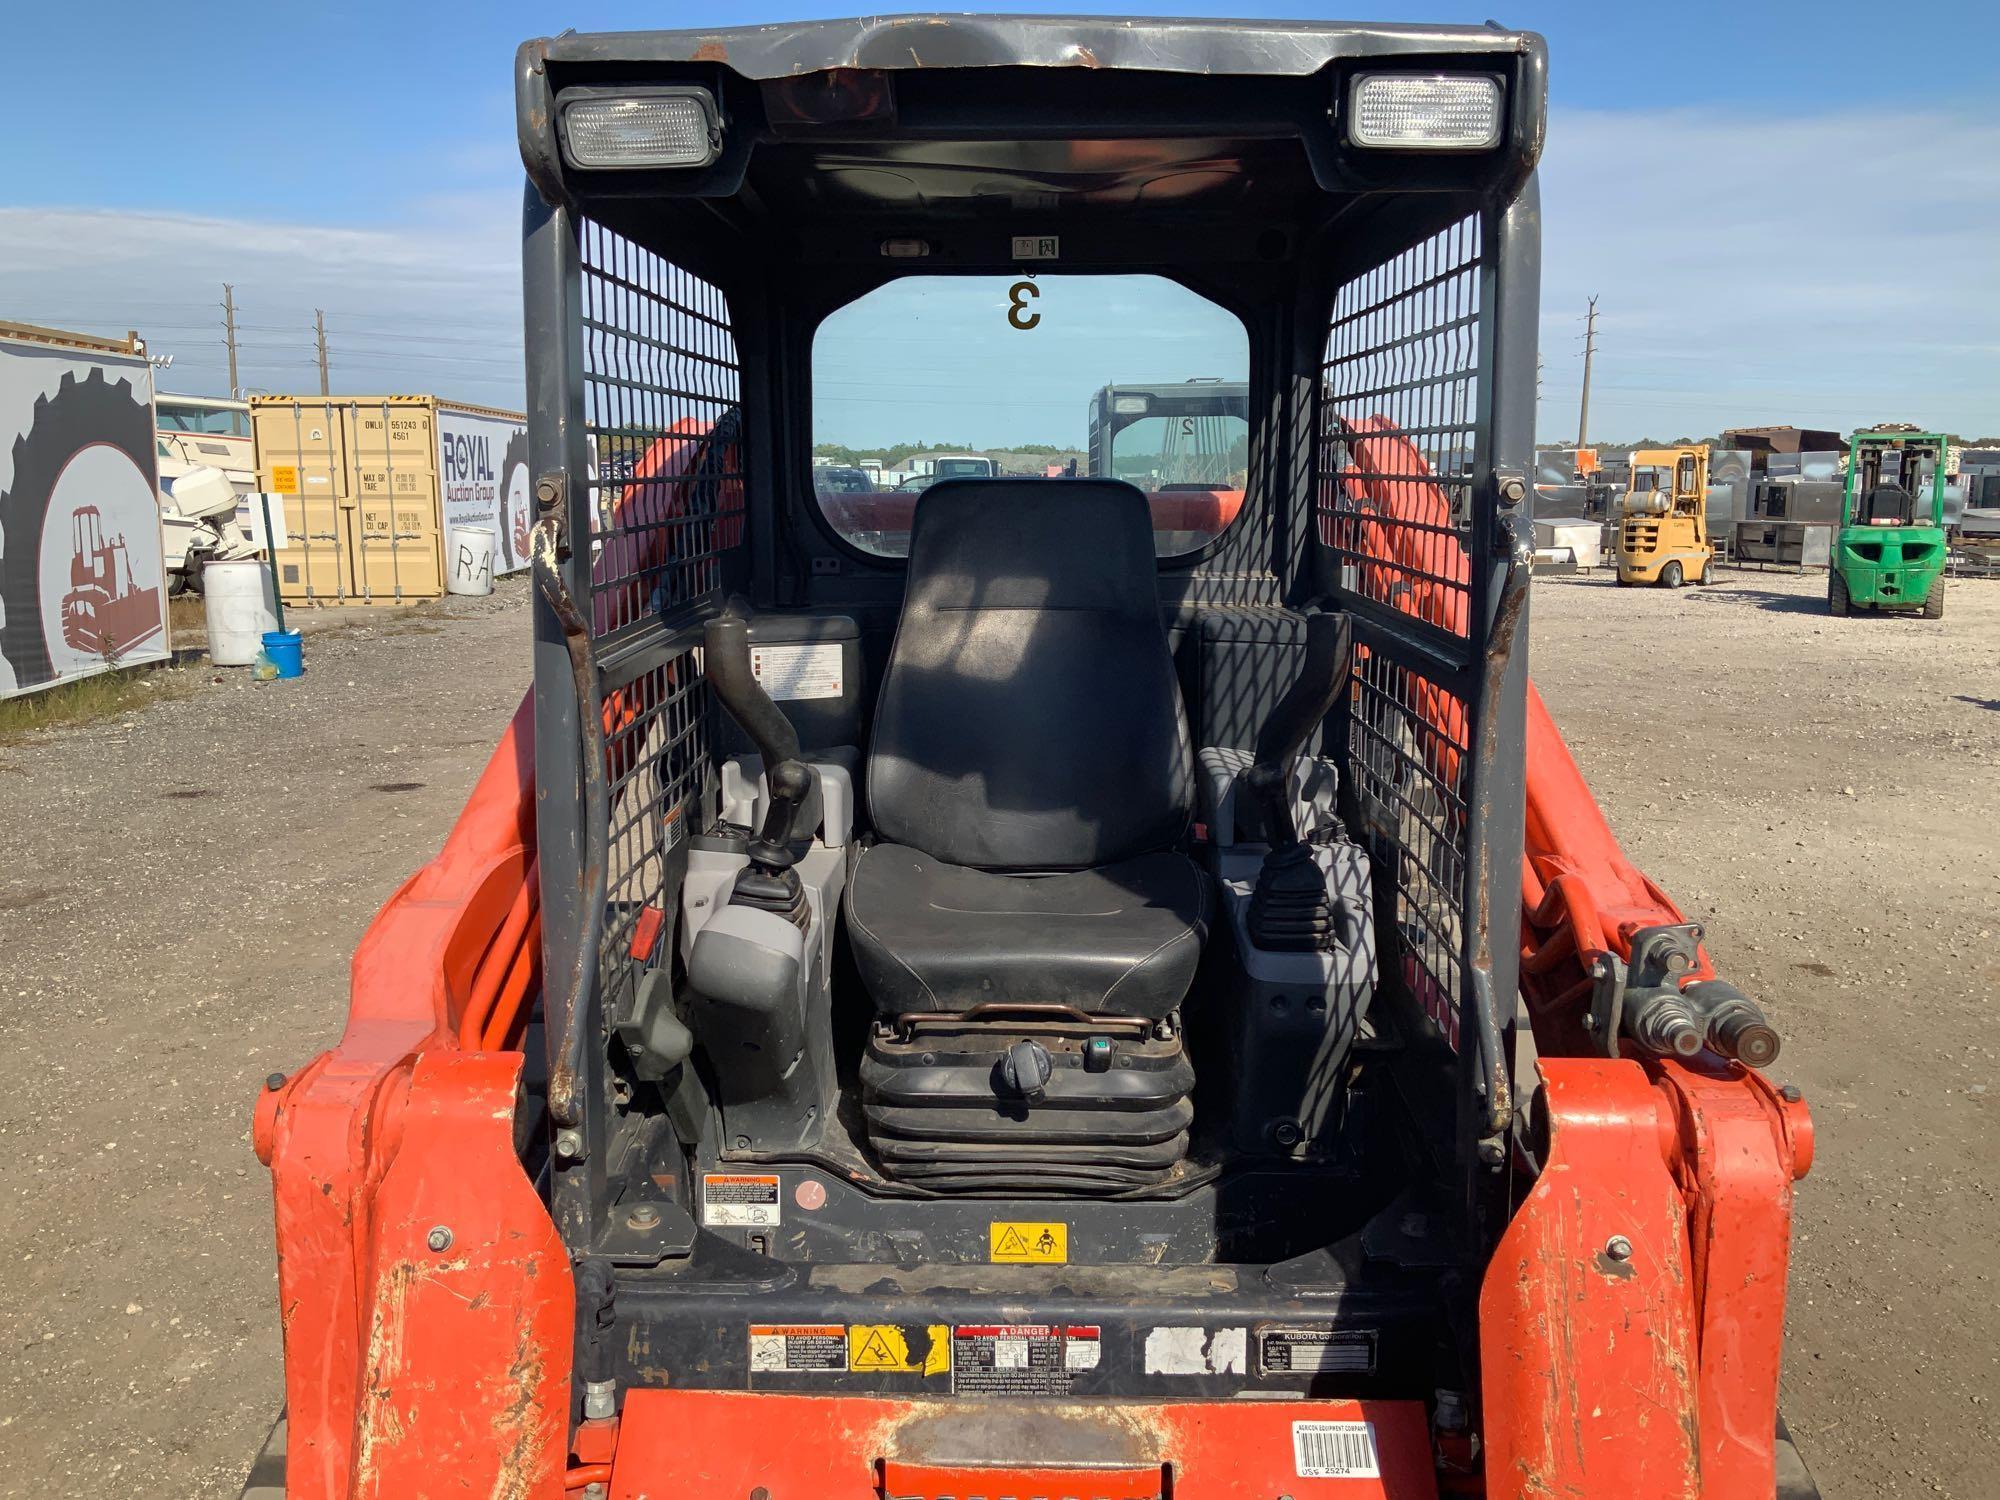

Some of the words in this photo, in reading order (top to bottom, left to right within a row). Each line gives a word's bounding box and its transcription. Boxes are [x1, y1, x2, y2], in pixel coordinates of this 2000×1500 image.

[365, 421, 383, 429] OWLU
[391, 421, 417, 429] 551243
[443, 432, 494, 481] ROYAL
[364, 483, 377, 491] TARE
[447, 483, 474, 502] Auction
[475, 483, 494, 508] Group
[366, 513, 376, 521] NET
[1285, 1333, 1317, 1341] KUBOTA
[1319, 1333, 1365, 1341] Corporation
